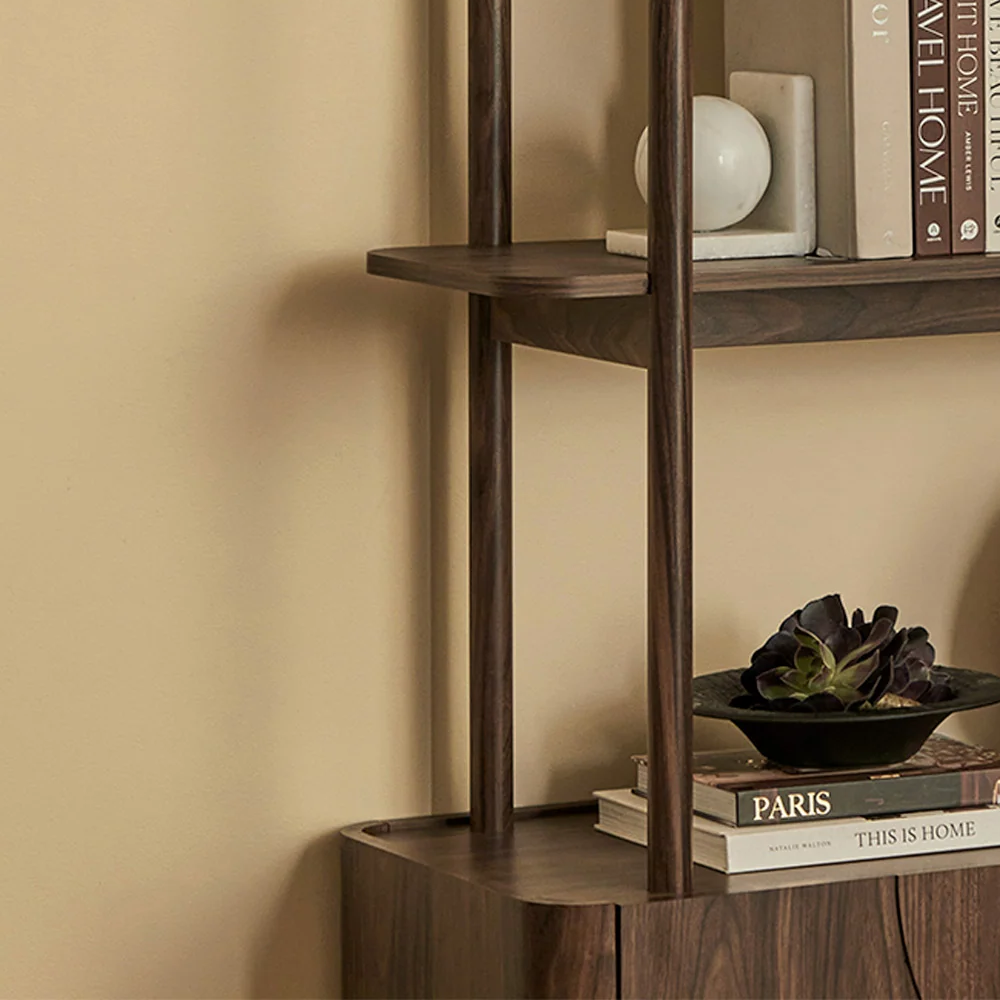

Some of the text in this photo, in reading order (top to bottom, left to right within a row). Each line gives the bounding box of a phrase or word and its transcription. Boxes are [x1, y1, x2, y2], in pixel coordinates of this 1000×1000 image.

[957, 2, 978, 26] IT
[957, 34, 979, 117] HOME
[918, 87, 947, 206] HOME
[964, 131, 973, 192] AMBER LEWIS
[753, 790, 832, 821] PARIS
[768, 840, 832, 853] NATALIE WALTON
[854, 821, 977, 848] THIS IS HOME
